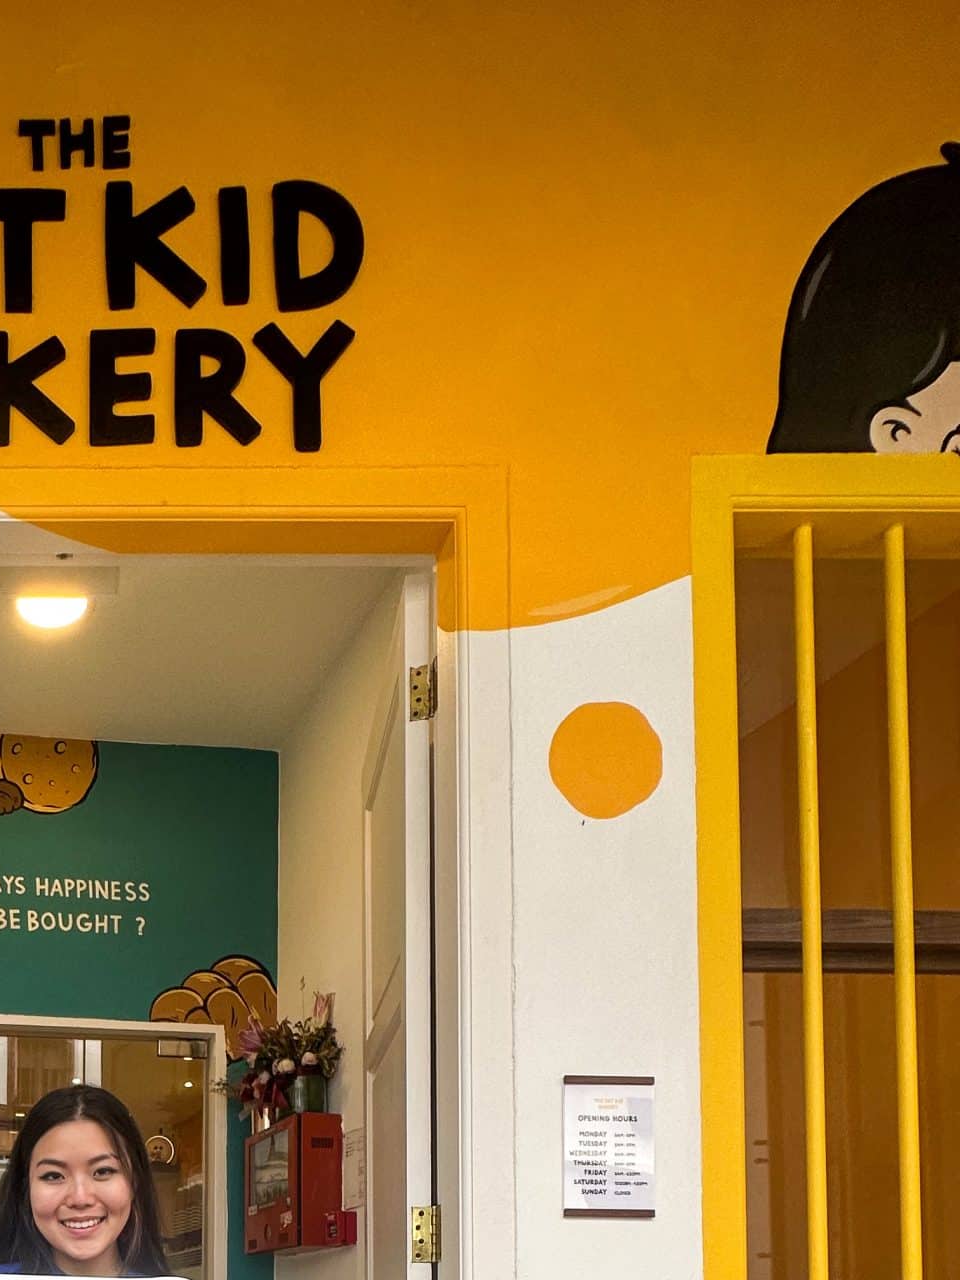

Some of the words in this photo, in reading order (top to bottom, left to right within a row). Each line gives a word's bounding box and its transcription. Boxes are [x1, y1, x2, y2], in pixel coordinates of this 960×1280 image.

[18, 114, 131, 171] THE
[105, 180, 365, 312] KID
[35, 876, 151, 902] HAPPINESS
[27, 909, 122, 935] BOUGHT
[135, 916, 146, 936] ?
[573, 1159, 608, 1167] THURSDAY
[573, 1178, 608, 1186] SATURDAY
